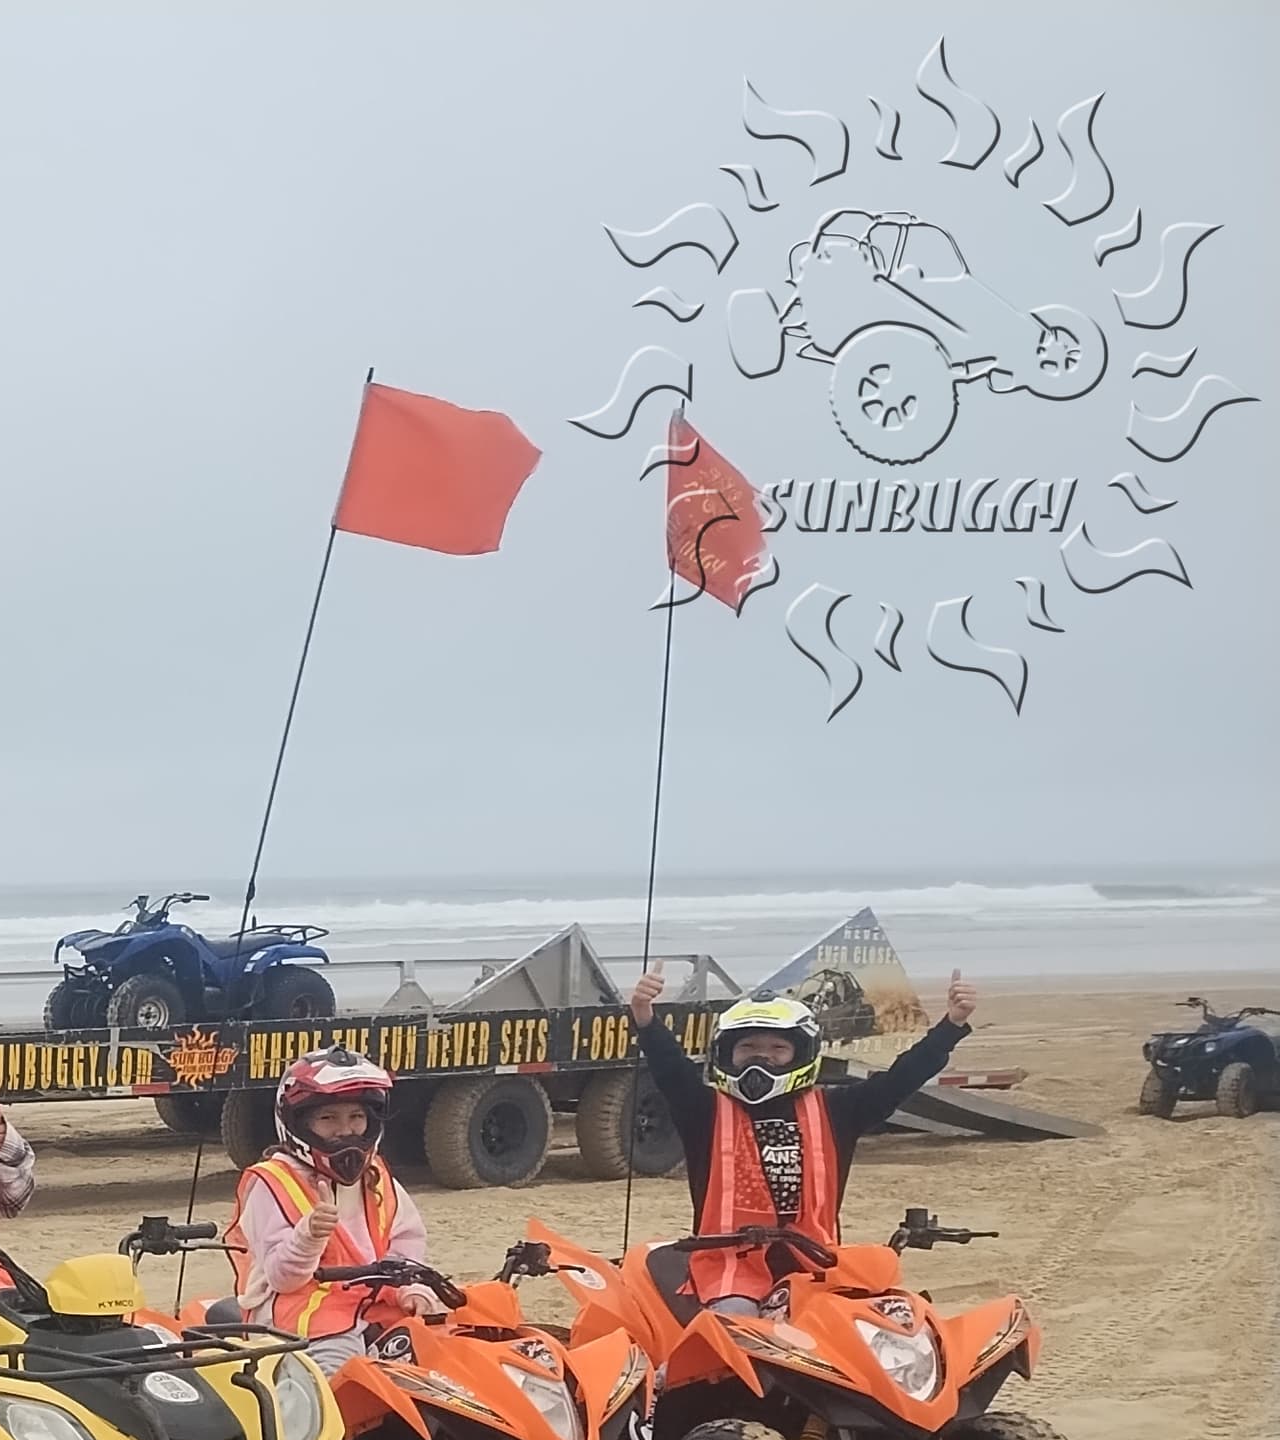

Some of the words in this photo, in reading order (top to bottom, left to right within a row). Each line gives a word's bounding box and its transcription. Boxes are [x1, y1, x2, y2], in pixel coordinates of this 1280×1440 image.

[379, 1025, 417, 1072] FUN
[427, 1021, 490, 1069] NEVER
[500, 1018, 548, 1065] SETS
[98, 1299, 134, 1309] KYMCO
